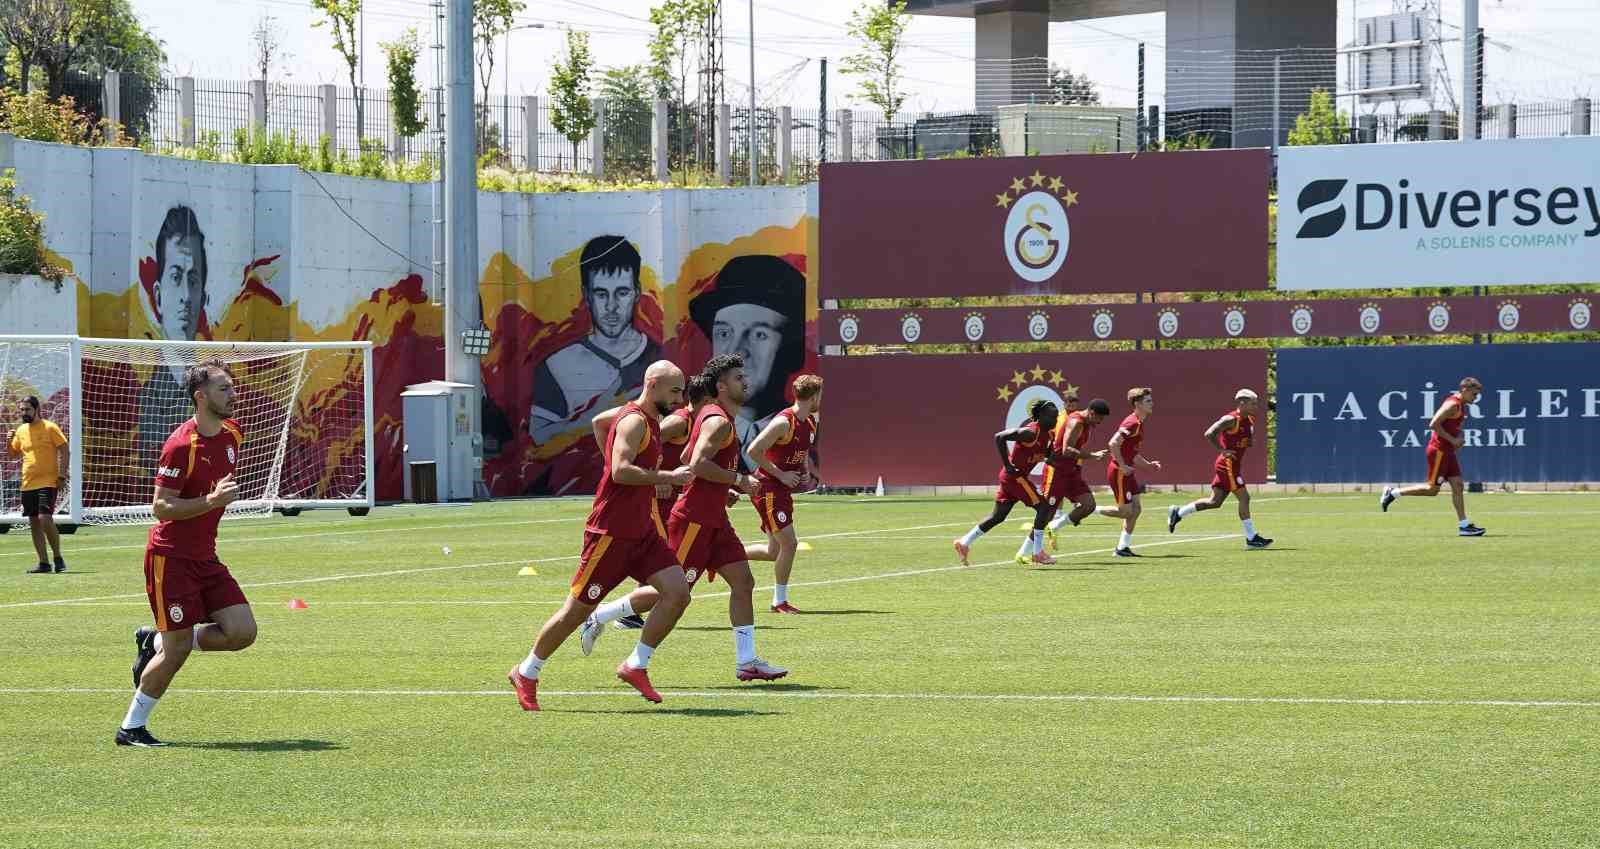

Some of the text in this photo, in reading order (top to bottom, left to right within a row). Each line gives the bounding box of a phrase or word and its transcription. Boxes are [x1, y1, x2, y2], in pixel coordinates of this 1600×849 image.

[1356, 178, 1600, 237] Diversey
[1416, 233, 1579, 250] A SOLENIS COMPANY
[1378, 428, 1526, 448] YARIM
